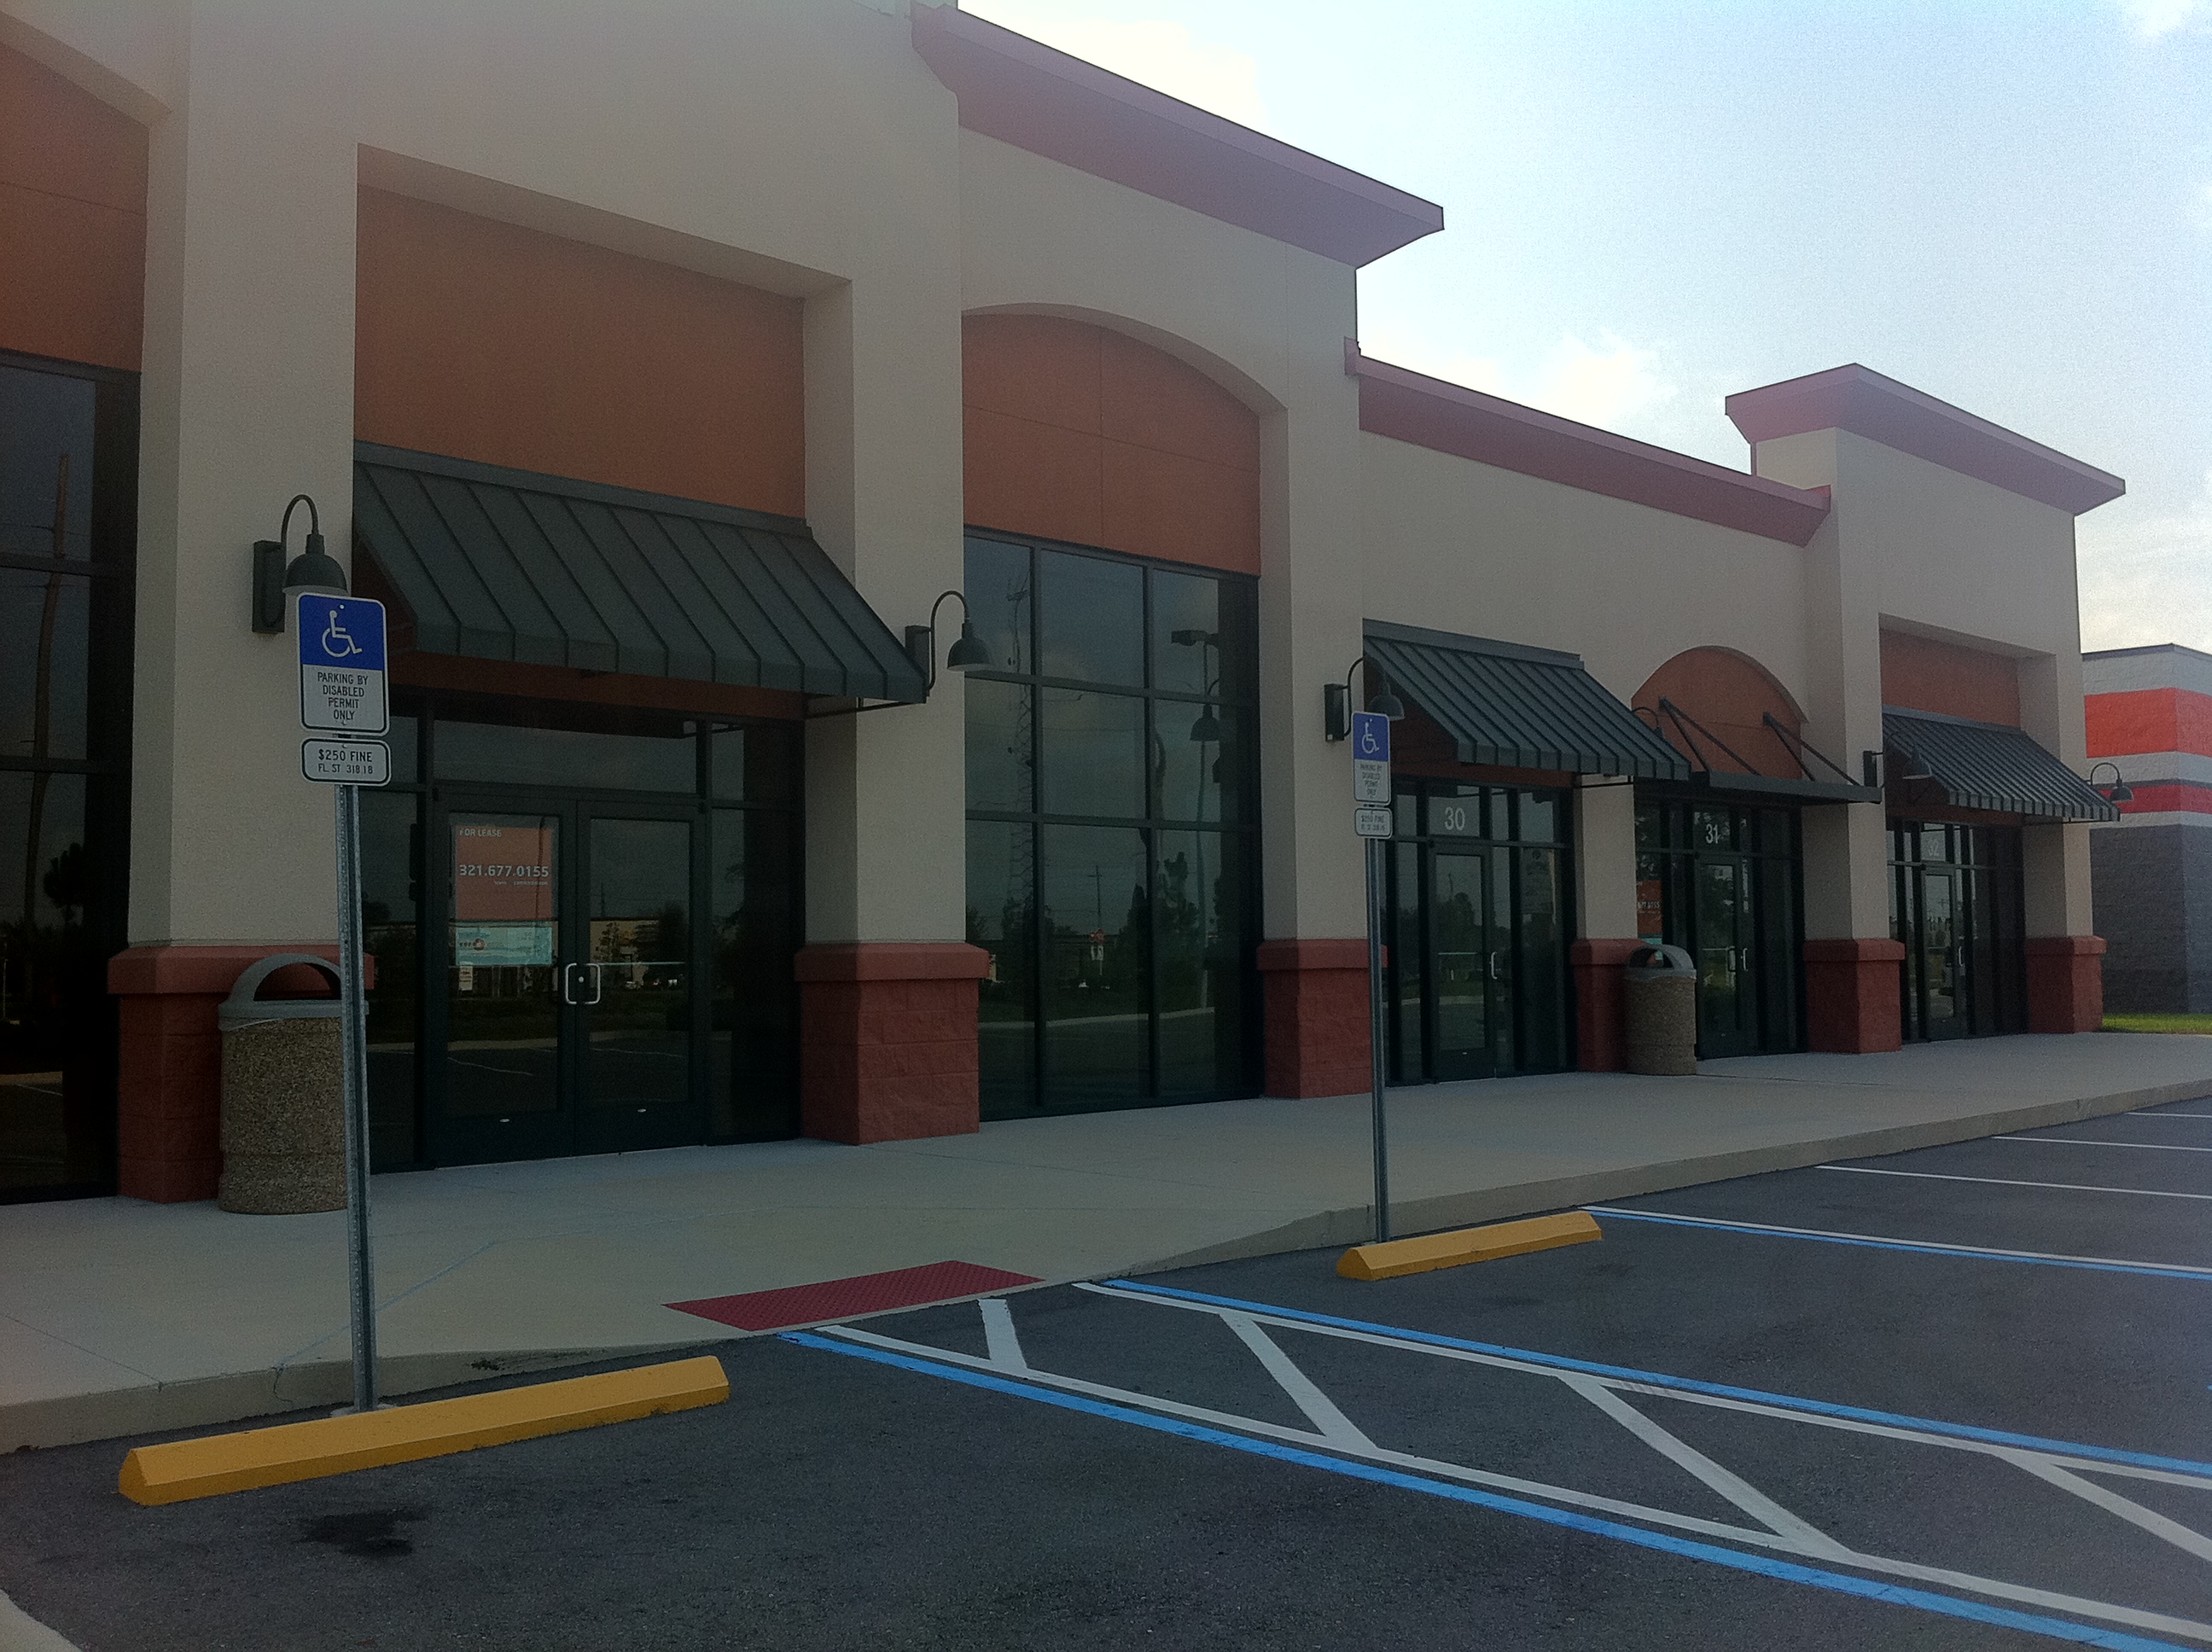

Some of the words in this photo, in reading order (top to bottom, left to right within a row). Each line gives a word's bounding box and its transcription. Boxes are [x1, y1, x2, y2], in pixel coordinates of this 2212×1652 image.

[317, 672, 353, 683] PARKING
[358, 675, 369, 685] BY
[323, 685, 364, 697] DISABLED
[328, 697, 360, 708] PERMIT
[333, 709, 355, 720] ONLY
[318, 748, 346, 761] $250
[350, 751, 373, 763] FINE
[1444, 806, 1465, 831] 30
[459, 828, 475, 836] FOR
[477, 829, 503, 838] LEASE
[1706, 823, 1718, 844] 31
[459, 864, 550, 878] 321.677.0155
